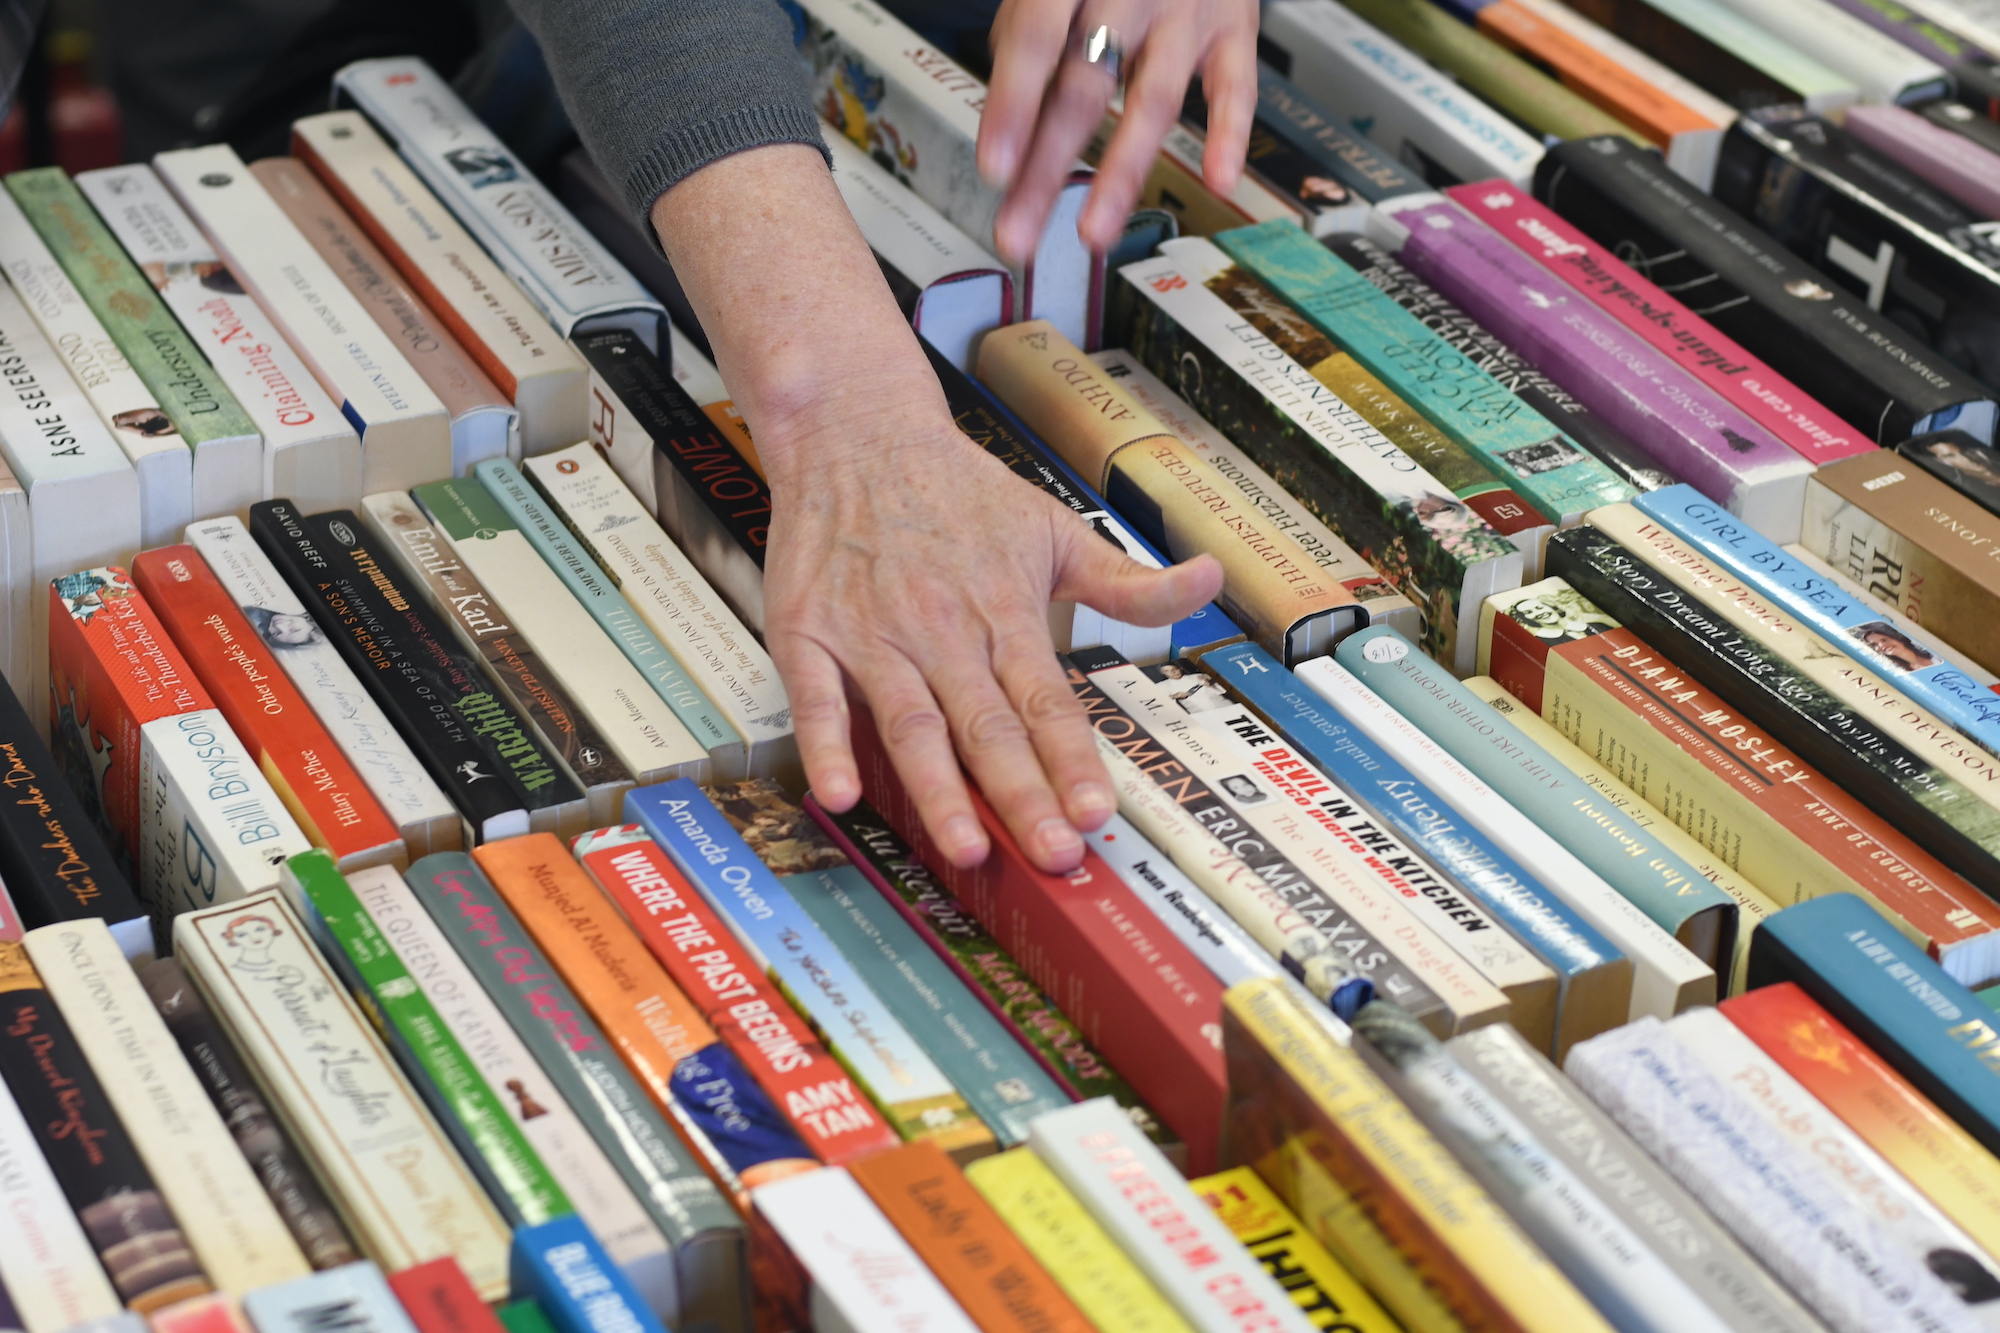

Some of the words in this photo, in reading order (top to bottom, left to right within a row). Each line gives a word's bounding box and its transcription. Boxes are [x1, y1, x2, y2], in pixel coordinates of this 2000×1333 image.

[195, 298, 251, 343] Noah
[1225, 318, 1288, 361] GIFT
[1357, 265, 1436, 315] BRUCE
[1417, 312, 1533, 393] CHATWIN
[1558, 312, 1658, 378] PROVENCE
[57, 330, 112, 389] BEYOND
[140, 329, 221, 417] Understory
[340, 341, 379, 371] JUERS
[1050, 358, 1100, 388] DO
[1407, 337, 1528, 420] WILLOW
[235, 343, 318, 426] Claiming
[370, 373, 409, 410] EVELYN
[1078, 384, 1131, 421] ANH
[1238, 358, 1304, 408] LITTLE
[1381, 343, 1501, 430] SACRED
[1655, 384, 1730, 430] PICNIC
[1737, 378, 1796, 413] caro
[33, 413, 85, 457] ÅSNE
[1276, 361, 1421, 472] CATHERINE'S
[1298, 408, 1359, 449] JOHN
[1351, 382, 1406, 420] MARK
[1405, 424, 1448, 458] SEAL
[1782, 412, 1849, 448] jane
[489, 465, 516, 485] END
[504, 483, 530, 502] THE
[670, 431, 777, 521] LOWE
[1149, 446, 1231, 512] REFUGEE
[1206, 455, 1300, 530] FitzSimons
[270, 506, 304, 536] DAVID
[295, 540, 327, 568] RIEFF
[523, 503, 560, 541] TOWARDS
[398, 527, 463, 574] Emil
[555, 544, 603, 596] SOMEWHERE
[643, 543, 683, 581] Friendship
[1219, 513, 1308, 583] HAPPIEST
[1289, 531, 1342, 567] Peter
[1681, 503, 1752, 548] GIRL
[1749, 550, 1796, 574] BY
[1791, 578, 1852, 617] SEA
[440, 573, 465, 591] and
[671, 579, 707, 612] Unlikely
[1631, 523, 1728, 588] Waging
[1717, 586, 1795, 634] Peace
[108, 597, 137, 619] Kid
[202, 613, 236, 643] words
[317, 582, 332, 590] A
[325, 592, 358, 625] SON'S
[350, 626, 391, 669] MEMOIR
[449, 592, 508, 635] Karl
[605, 605, 661, 656] ATHILL
[703, 621, 727, 631] of
[1587, 541, 1615, 557] A
[1604, 554, 1658, 591] Story
[1654, 589, 1727, 639] Dreamt
[1721, 636, 1775, 676] Long
[1767, 671, 1816, 705] Ago
[106, 623, 130, 649] Times
[118, 648, 141, 664] and
[124, 619, 181, 687] Thunderbolt
[334, 579, 384, 632] SWIMMING
[377, 635, 395, 646] IN
[396, 661, 421, 682] SEA
[415, 685, 437, 701] OF
[429, 703, 467, 742] DEATH
[715, 630, 741, 652] Story
[130, 665, 152, 683] Life
[222, 643, 267, 682] people's
[649, 657, 702, 709] DIANA
[731, 651, 755, 671] True
[1392, 658, 1452, 700] PEOPLE'S
[143, 683, 164, 702] The
[171, 687, 195, 710] The
[251, 683, 285, 715] Other
[613, 688, 643, 721] Memoirs
[1277, 691, 1345, 737] gardner
[1444, 698, 1496, 735] OTHER
[1612, 644, 1699, 703] DIANA
[1698, 707, 1814, 784] MOSLEY
[641, 724, 666, 748] AMIS
[1138, 697, 1166, 715] M.
[1163, 719, 1219, 765] Homes
[1322, 662, 1353, 684] CLIVE
[1349, 685, 1382, 709] JAMES
[1382, 712, 1442, 757] UNRELIABLE
[1441, 759, 1488, 795] MEMOIRS
[1487, 735, 1525, 759] LIKE
[1839, 667, 1898, 707] ANNE
[1898, 711, 2000, 782] DEVESON
[172, 708, 251, 802] Bryson
[298, 749, 339, 791] McPhee
[1330, 736, 1382, 772] nuala
[1516, 758, 1552, 781] LIFE
[1826, 707, 1887, 756] Phyllis
[1887, 751, 1959, 804] McDuff
[326, 791, 363, 826] Hilary
[1578, 773, 1631, 808] Byrski
[221, 799, 280, 848] Bill
[1078, 679, 1207, 823] WOMEN
[1194, 791, 1258, 864] ERIC
[1256, 850, 1390, 973] METAXAS
[1221, 714, 1273, 748] THE
[1259, 746, 1330, 798] DEVIL
[1319, 795, 1351, 817] IN
[1348, 821, 1397, 855] THE
[1387, 855, 1488, 934] KITCHEN
[1253, 759, 1313, 808] marco
[1306, 805, 1366, 854] pierre
[1363, 852, 1424, 898] white
[1570, 797, 1649, 857] Bennett
[1620, 808, 1656, 828] Liz
[659, 796, 732, 864] Amanda
[714, 863, 778, 919] Owen
[1803, 801, 1848, 830] ANNE
[1845, 831, 1872, 848] DE
[1866, 848, 1936, 895] COURCY
[522, 863, 582, 916] Munjed
[608, 844, 689, 920] WHERE
[851, 825, 903, 854] Au
[887, 863, 982, 936] Revoir
[1645, 858, 1696, 898] Alan
[568, 912, 598, 936] Al
[1270, 813, 1306, 840] The
[1306, 846, 1393, 921] Mistress's
[1392, 925, 1478, 998] Daughter
[658, 908, 719, 957] THE
[360, 883, 404, 915] THE
[384, 917, 450, 979] QUEEN
[427, 979, 467, 1005] OF
[451, 1008, 511, 1070] KATWE
[581, 932, 645, 993] Muderis
[687, 944, 759, 1007] PAST
[726, 994, 816, 1077] BEGINS
[628, 997, 713, 1079] Walking
[692, 1077, 762, 1134] Free
[777, 1071, 861, 1121] AMY
[798, 1097, 876, 1145] TAN
